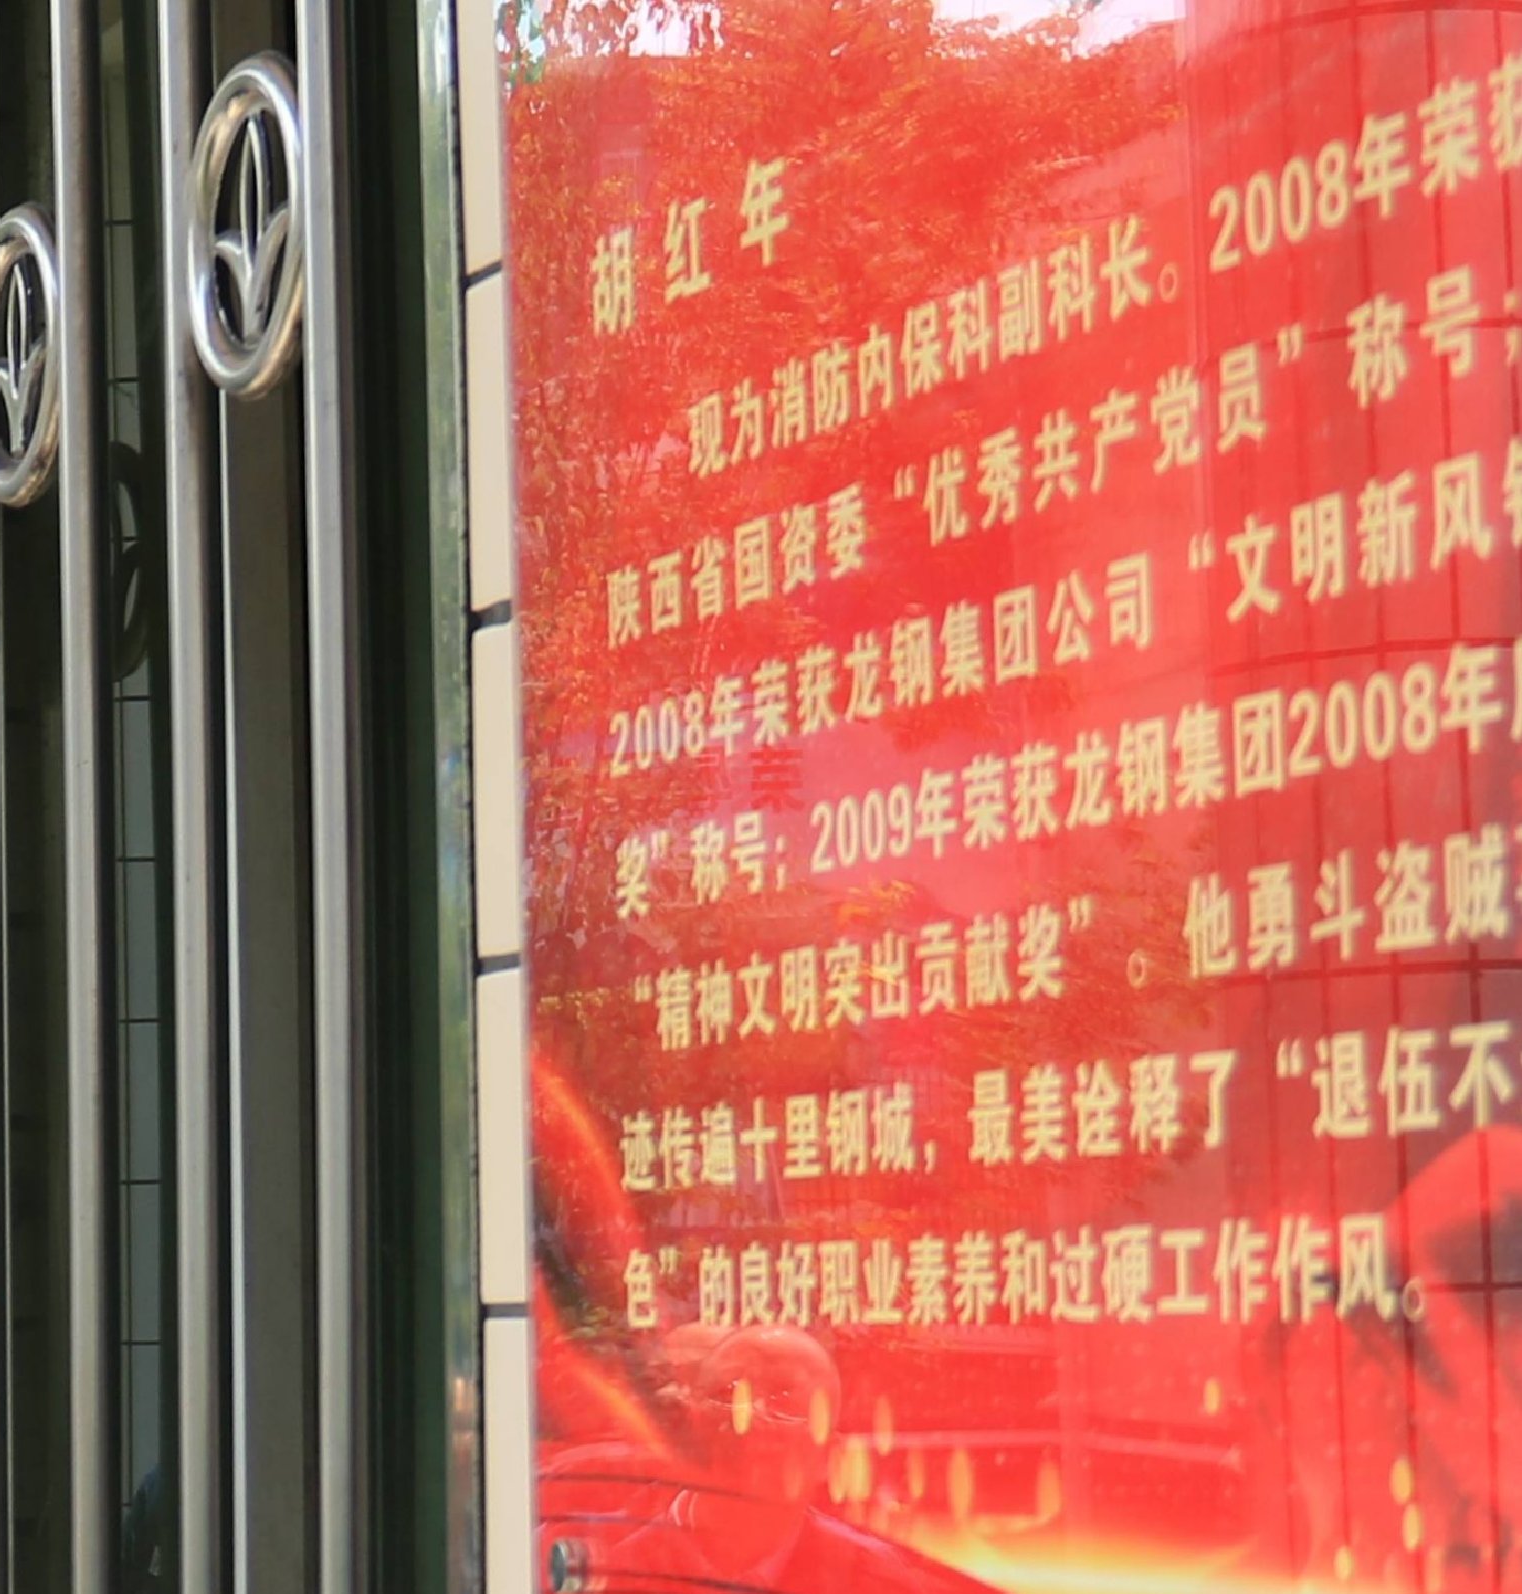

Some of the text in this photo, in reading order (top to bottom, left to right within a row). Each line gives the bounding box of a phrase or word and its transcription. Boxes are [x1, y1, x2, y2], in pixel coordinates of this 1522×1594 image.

[608, 437, 1522, 778] 2008年荣获龙钢集团公司“文明新风
[615, 634, 1522, 919] 奖”称号；2009年荣获龙钢集团2008年
[633, 822, 1522, 1051] “精神文明突出贡献奖”。他勇斗盗贼
[619, 1019, 1522, 1192] 迹传遍十里钢城，最美诠释了“退伍不
